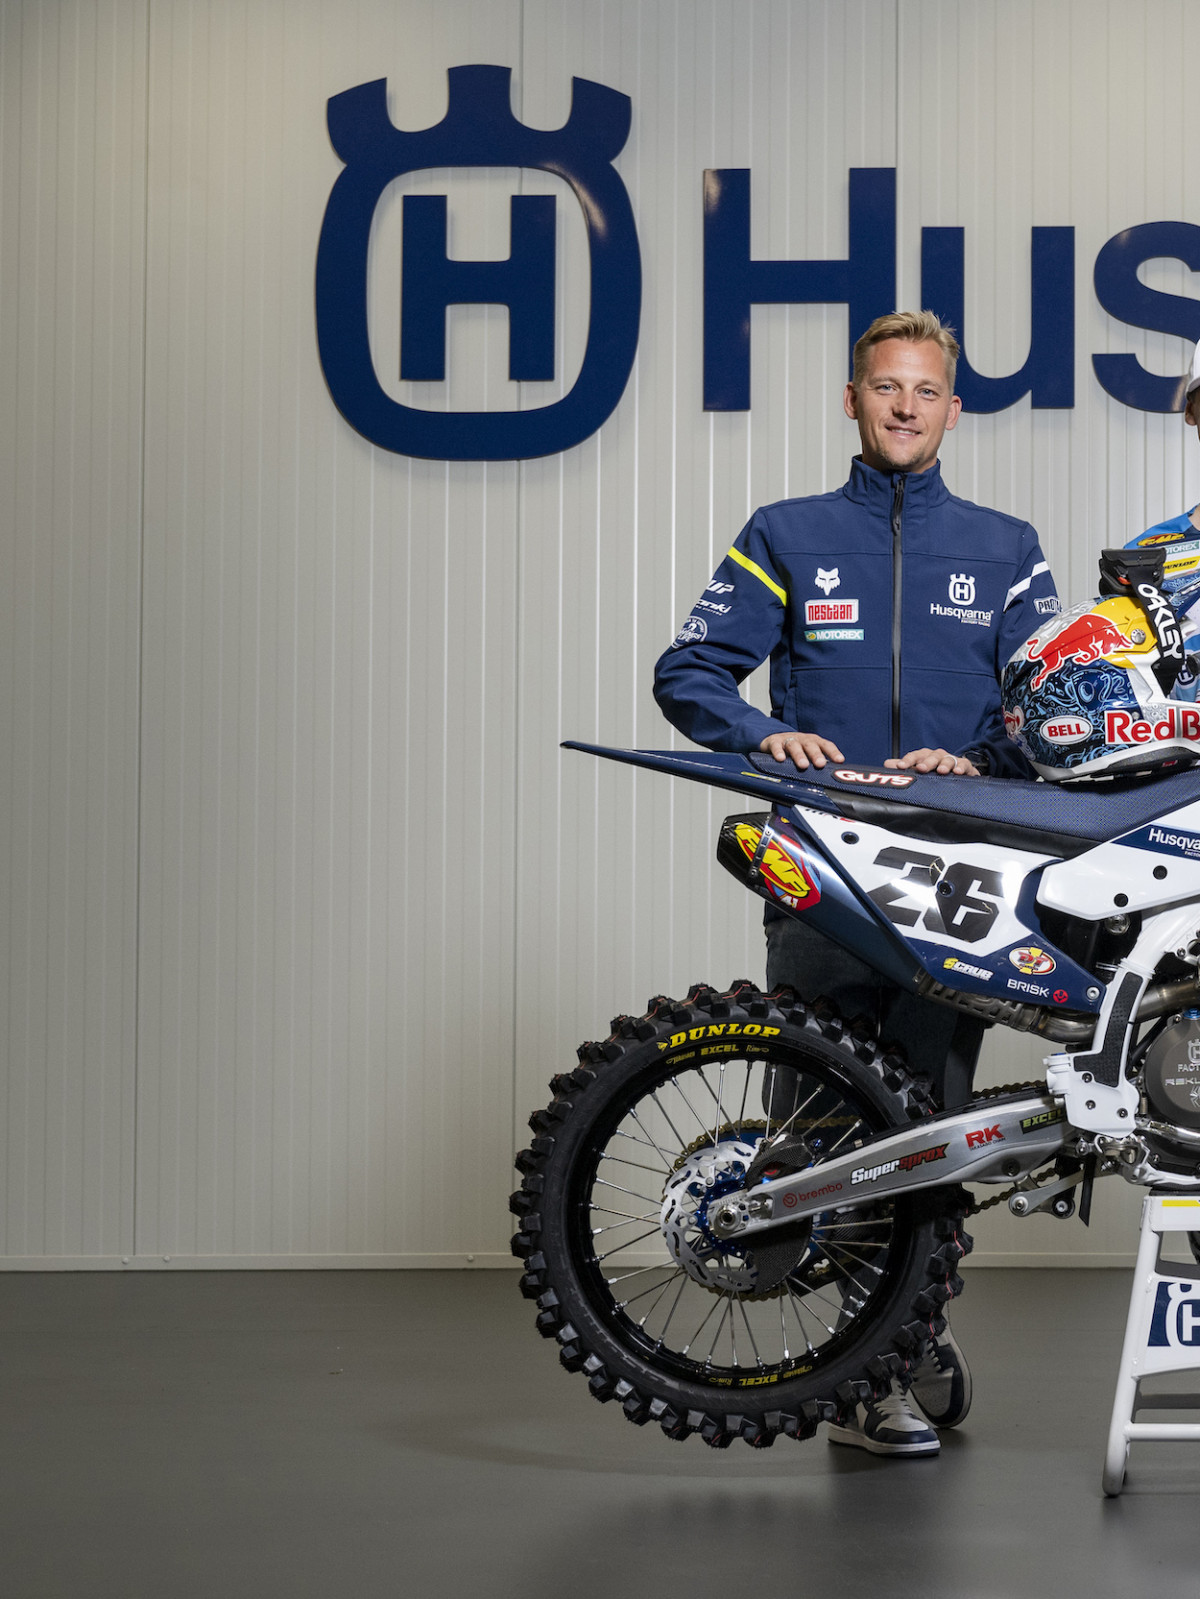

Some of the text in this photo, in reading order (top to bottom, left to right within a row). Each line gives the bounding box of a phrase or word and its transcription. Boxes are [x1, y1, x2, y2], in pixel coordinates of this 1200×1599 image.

[1165, 542, 1198, 554] OTOREX
[808, 604, 853, 621] nestaan
[930, 603, 992, 621] Husqvarna
[1137, 583, 1183, 660] OAKLEY
[816, 630, 862, 640] MOTOREX
[1047, 723, 1085, 738] BELL
[1107, 708, 1175, 743] Red
[834, 769, 915, 788] GUTS
[865, 846, 1005, 943] 26
[943, 957, 994, 980] SCRUB
[1007, 978, 1050, 998] BRISK
[669, 1023, 781, 1049] DUNLOP
[701, 1044, 740, 1056] EXCEL
[965, 1123, 1005, 1149] RK
[798, 1182, 843, 1201] brembo
[738, 1373, 779, 1387] EXCEL
